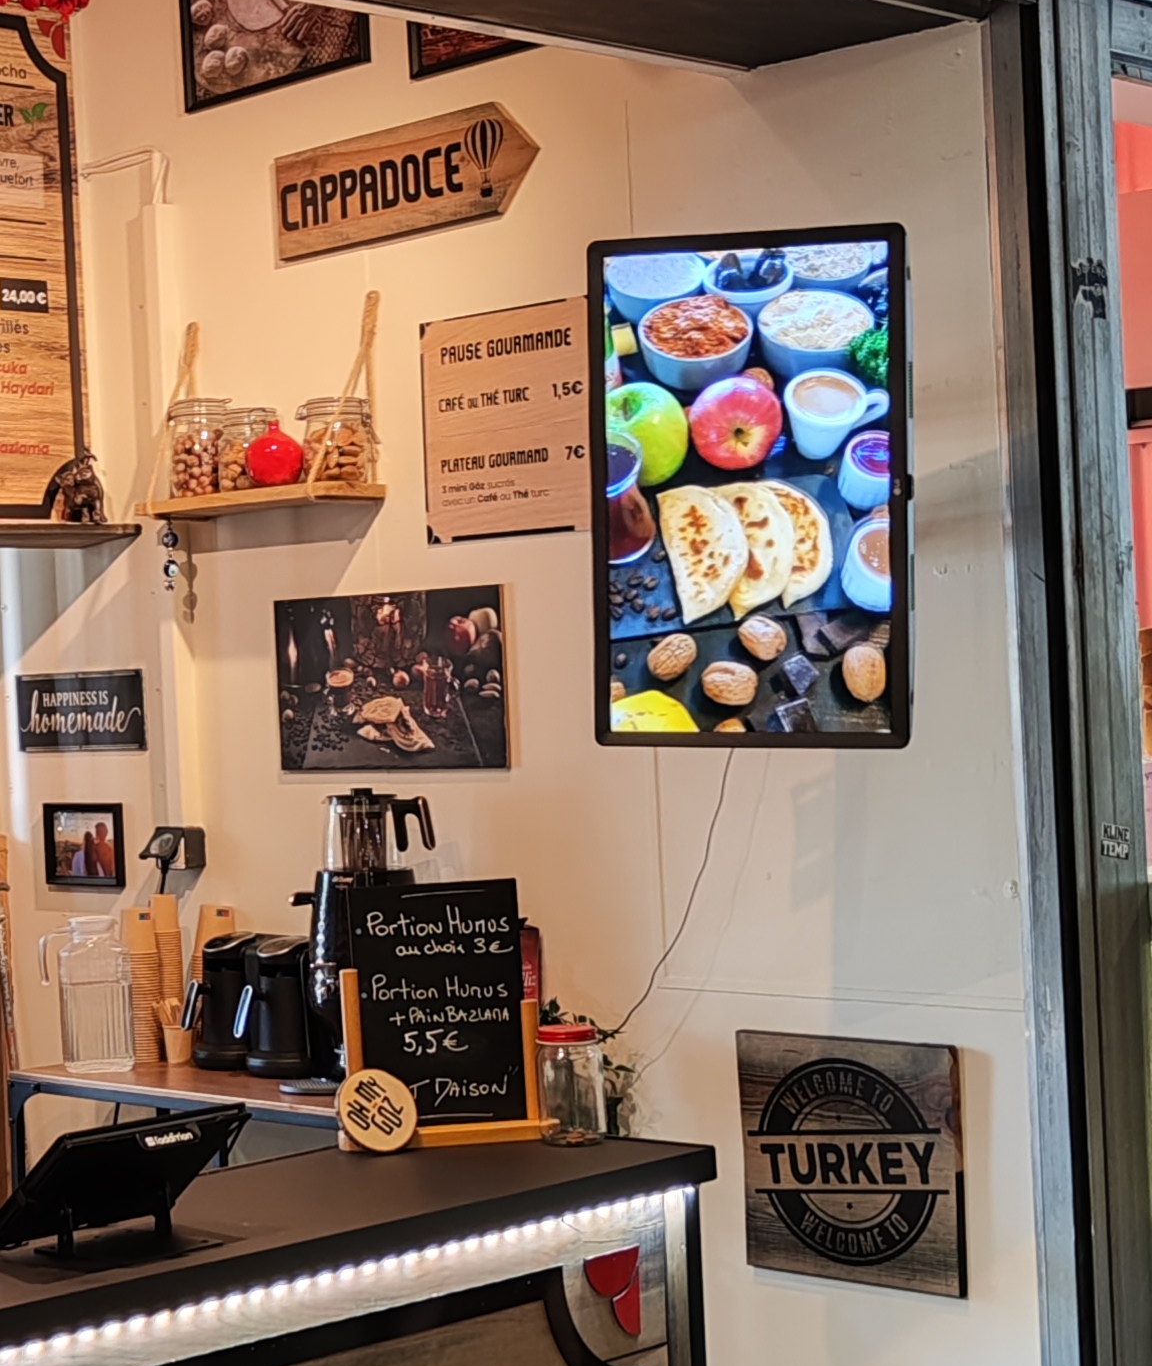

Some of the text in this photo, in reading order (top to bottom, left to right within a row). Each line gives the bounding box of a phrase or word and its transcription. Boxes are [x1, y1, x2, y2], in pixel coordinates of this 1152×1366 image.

[280, 141, 462, 232] CAPPADOCE
[440, 327, 571, 365] PAUSE GOURMANDE
[438, 387, 530, 413] CAFÉ THÉ TURC
[441, 447, 548, 474] PLATEAU GOURMAND
[565, 445, 585, 460] 7€
[20, 689, 141, 734] homemade
[42, 691, 97, 707] HAPPINESS
[395, 943, 421, 956] au
[779, 1070, 894, 1115] WELCOME TO
[760, 1141, 935, 1185] TURKEY
[800, 1210, 909, 1255] WELCOME TO
